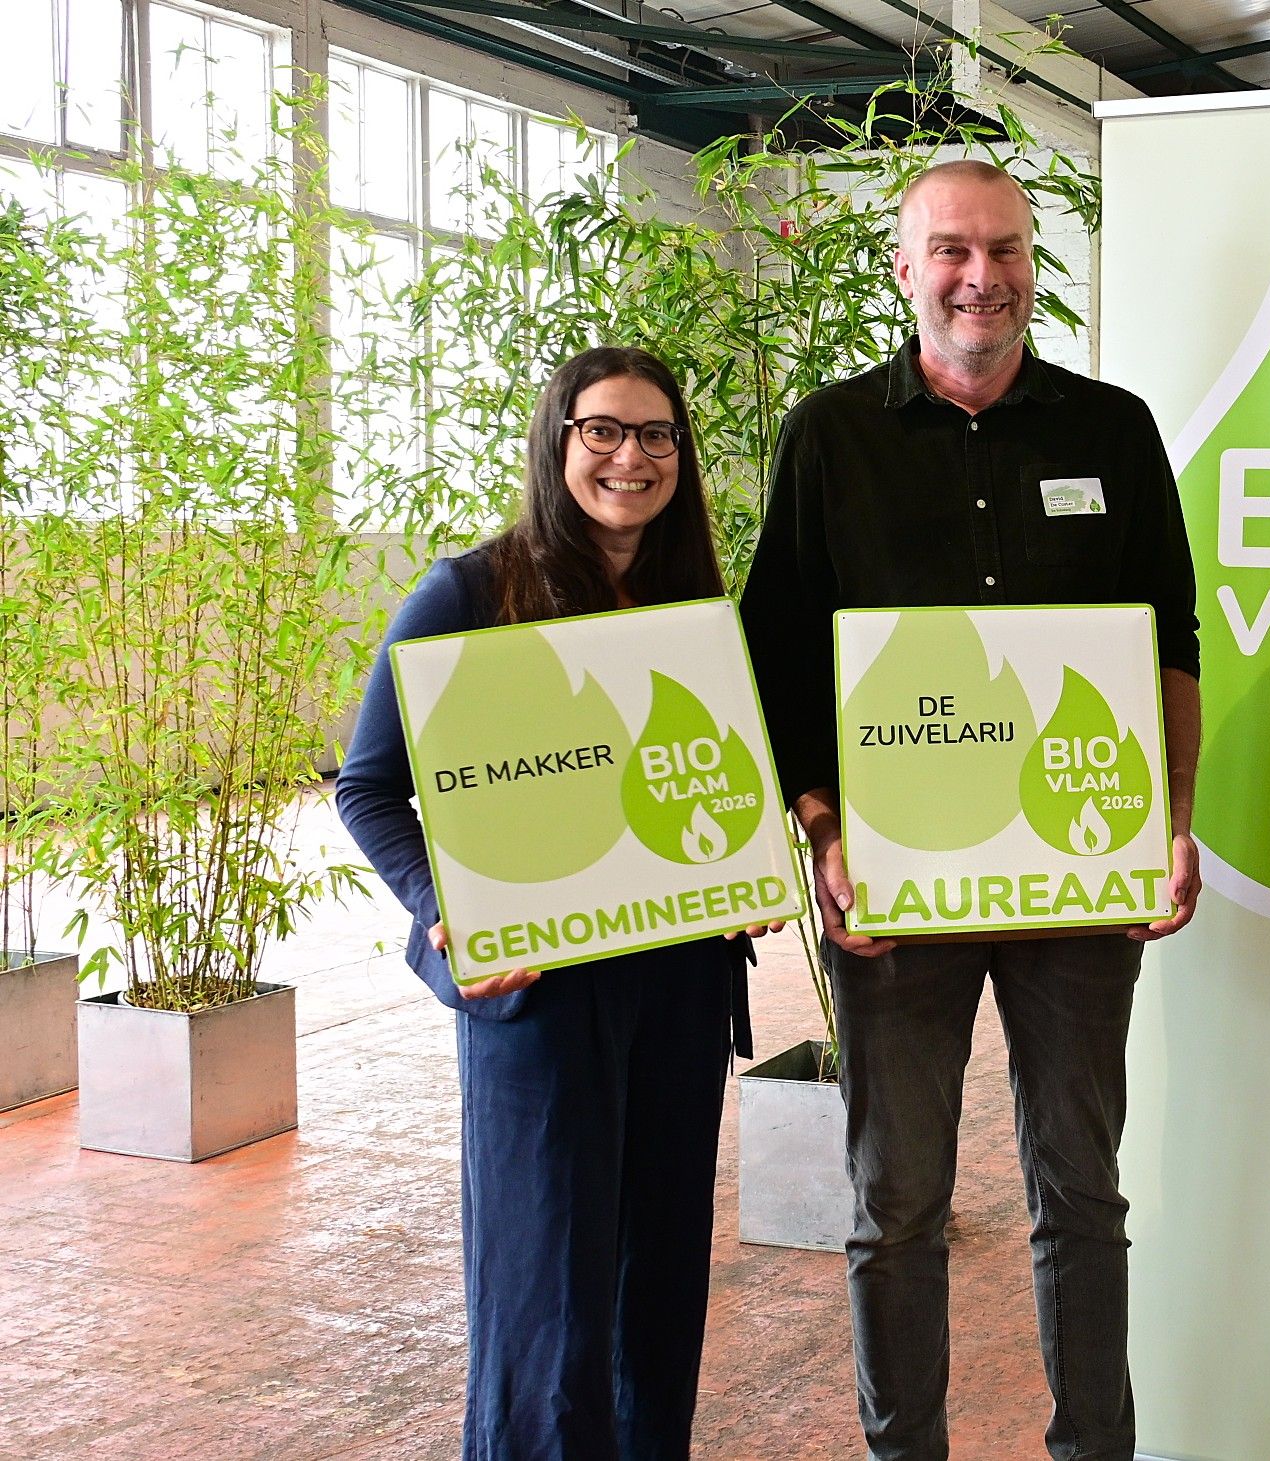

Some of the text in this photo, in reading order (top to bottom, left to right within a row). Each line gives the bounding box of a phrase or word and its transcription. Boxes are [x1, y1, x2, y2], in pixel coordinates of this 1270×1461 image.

[918, 696, 956, 717] DE
[859, 722, 1014, 746] ZUIVELARIJ
[435, 744, 614, 793] DE MAKKER
[640, 737, 722, 780] BIO
[1042, 735, 1118, 770] BIO
[648, 772, 729, 804] VLAM
[1045, 772, 1120, 793] VLAM
[712, 793, 757, 814] 2026
[1101, 795, 1144, 810] 2026
[856, 869, 1166, 924] LAUREAAT
[467, 876, 787, 963] GENOMINEERD
